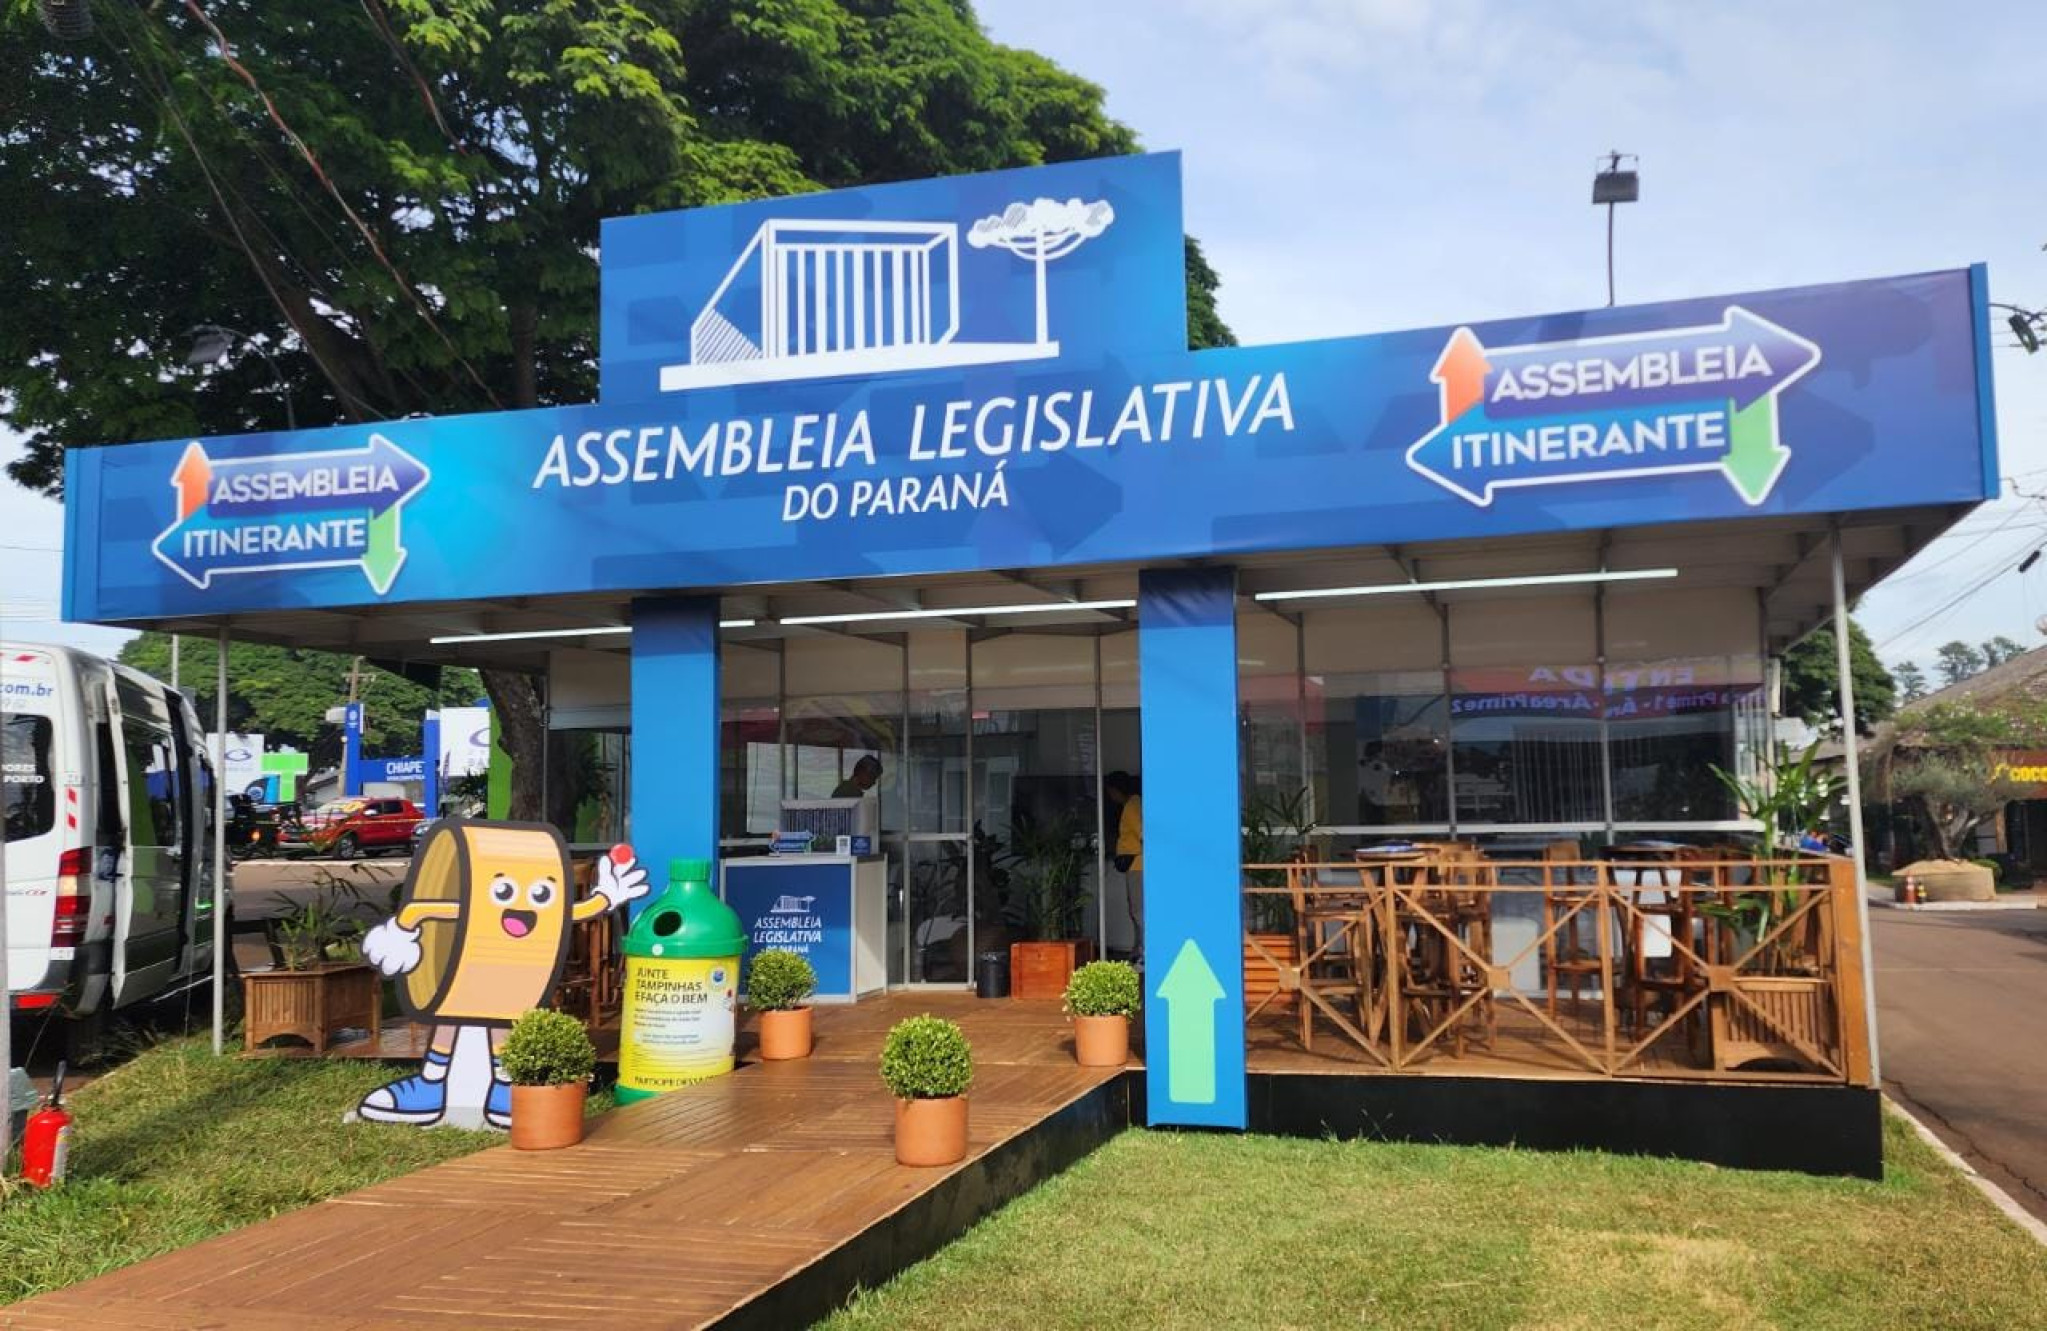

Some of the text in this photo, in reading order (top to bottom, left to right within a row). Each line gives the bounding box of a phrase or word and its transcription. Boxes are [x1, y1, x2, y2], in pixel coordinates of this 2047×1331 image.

[1490, 344, 1773, 403] ASSEMBLEIA
[532, 372, 1295, 488] ASSEMBLEIA LEGISLATIVA
[1452, 411, 1726, 469] ITINERANTE
[210, 464, 399, 504] ASSEMBLEIA
[782, 460, 1009, 521] DO PARANÁ
[183, 518, 366, 558] ITINERANTE
[753, 930, 823, 943] LEGISLATIVA
[754, 916, 823, 929] ASSEMBLEIA
[636, 979, 703, 992] TAMPINHAS
[637, 968, 670, 979] JUNTE
[682, 992, 708, 1004] BEM
